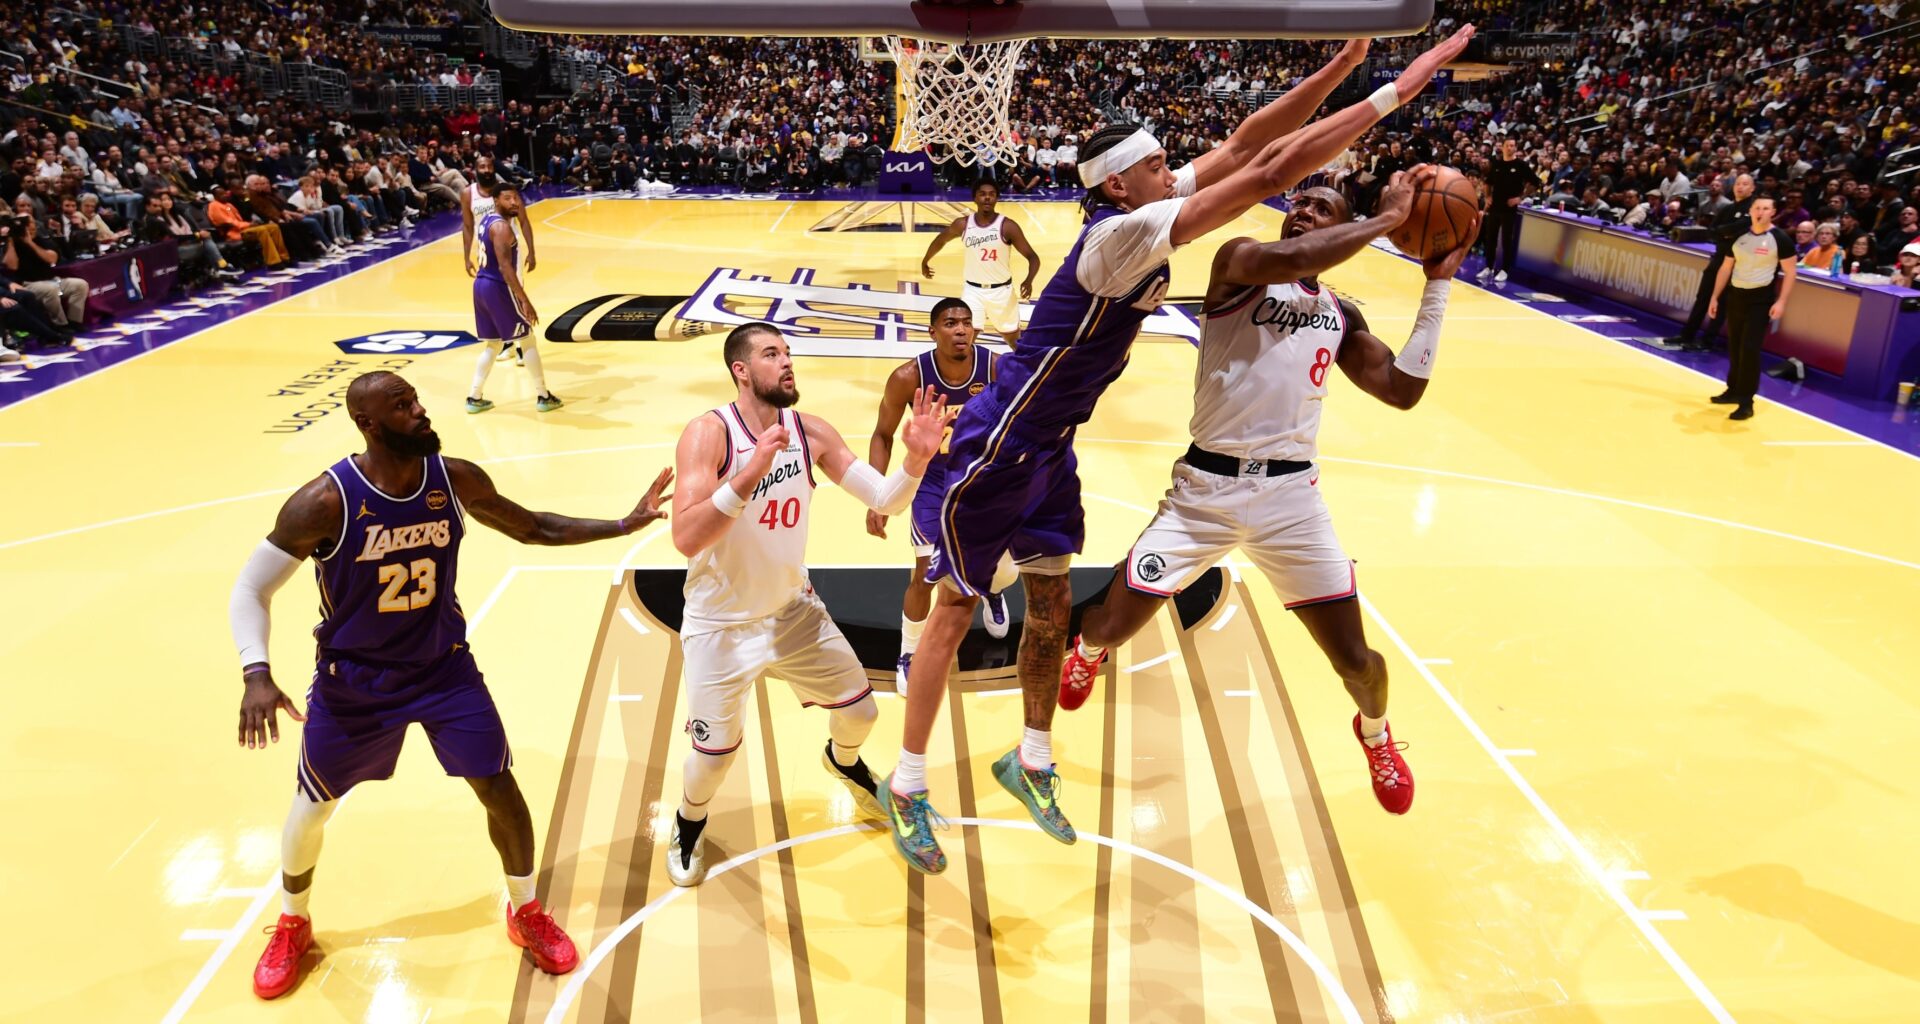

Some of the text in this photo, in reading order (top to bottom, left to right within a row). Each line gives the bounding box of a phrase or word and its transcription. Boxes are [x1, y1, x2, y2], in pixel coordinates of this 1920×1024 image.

[403, 33, 442, 42] EXPRESS
[886, 162, 925, 173] KIA
[965, 233, 998, 248] Clippers
[981, 248, 998, 262] 24
[1572, 239, 1610, 285] COAST
[1606, 248, 1618, 288] 2
[1615, 250, 1657, 299] COAST
[1251, 296, 1341, 335] Clippers
[267, 359, 360, 397] ARENA
[1309, 347, 1331, 388] 8
[759, 496, 801, 530] 40
[355, 519, 451, 562] LAKERS
[378, 557, 437, 613] 23
